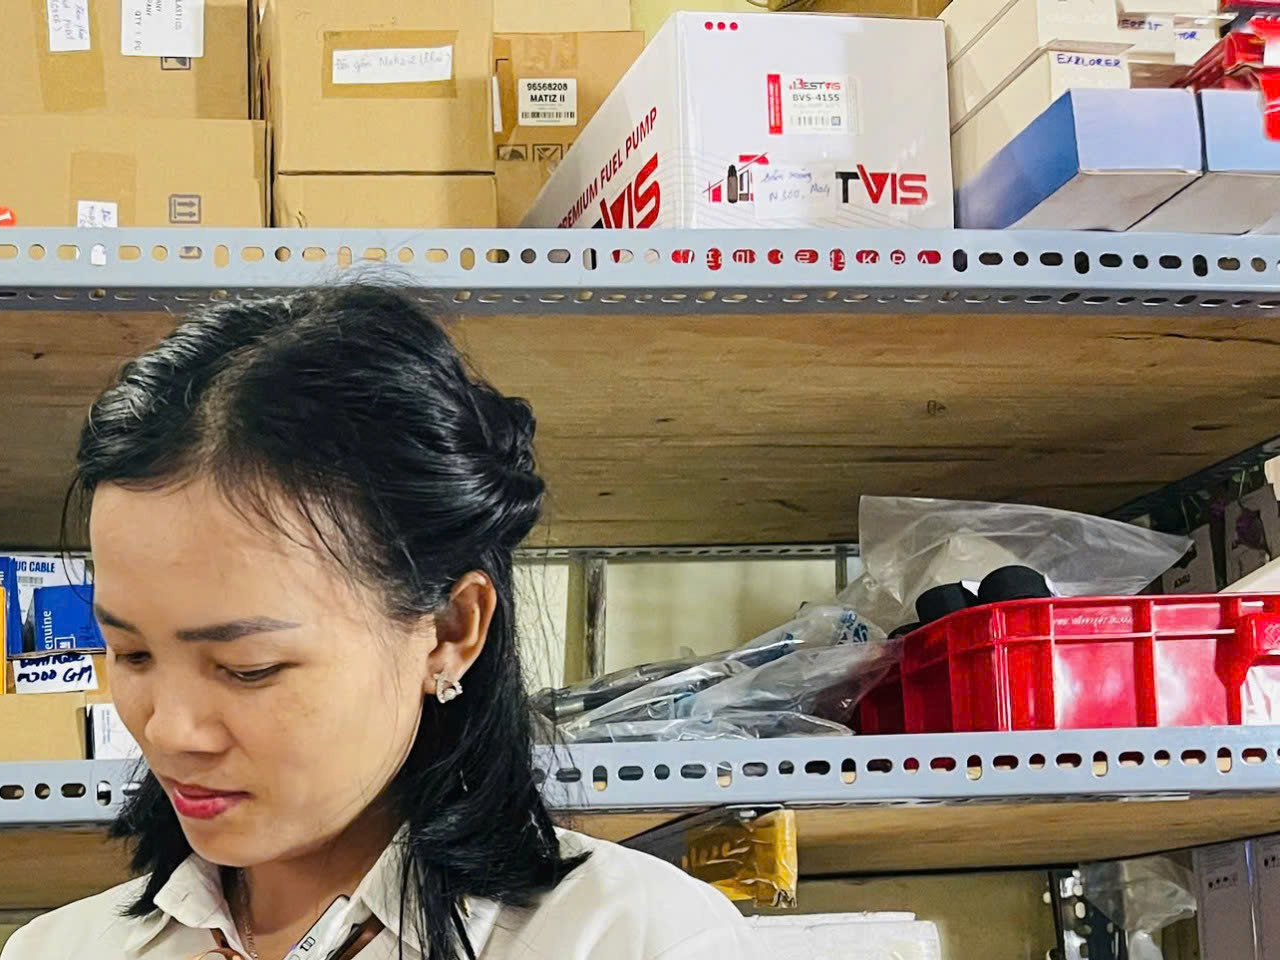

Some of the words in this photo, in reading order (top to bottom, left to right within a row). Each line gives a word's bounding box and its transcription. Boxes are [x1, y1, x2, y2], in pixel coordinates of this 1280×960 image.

[527, 83, 568, 91] 96568208
[530, 94, 557, 103] MATIZ
[559, 94, 565, 103] II
[793, 93, 840, 102] BVS-4155
[600, 148, 623, 190] FUEL
[625, 106, 657, 159] PUMP
[835, 164, 929, 206] TVIS
[29, 562, 56, 573] CABLE
